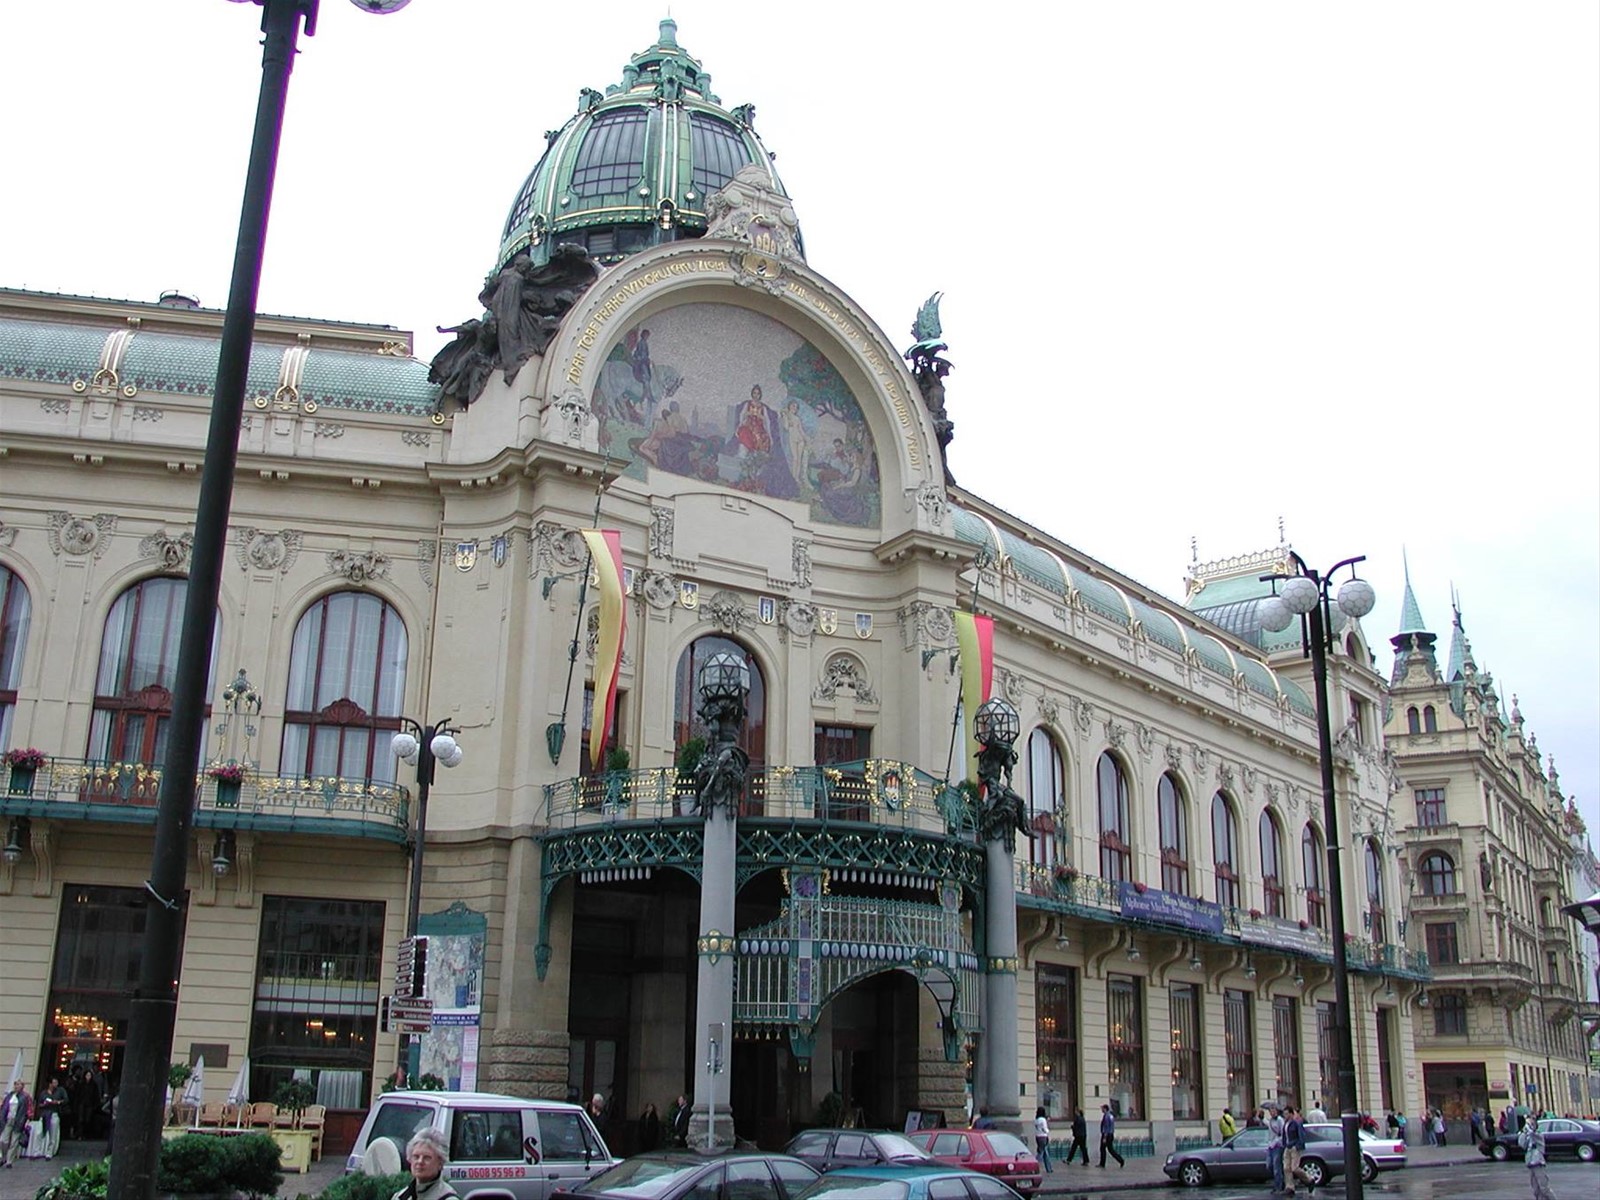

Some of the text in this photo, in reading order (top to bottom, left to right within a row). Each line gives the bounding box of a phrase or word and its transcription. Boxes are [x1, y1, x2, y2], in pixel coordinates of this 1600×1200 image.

[567, 351, 587, 385] ZDAR
[524, 1136, 541, 1165] S
[468, 1167, 490, 1178] 0608
